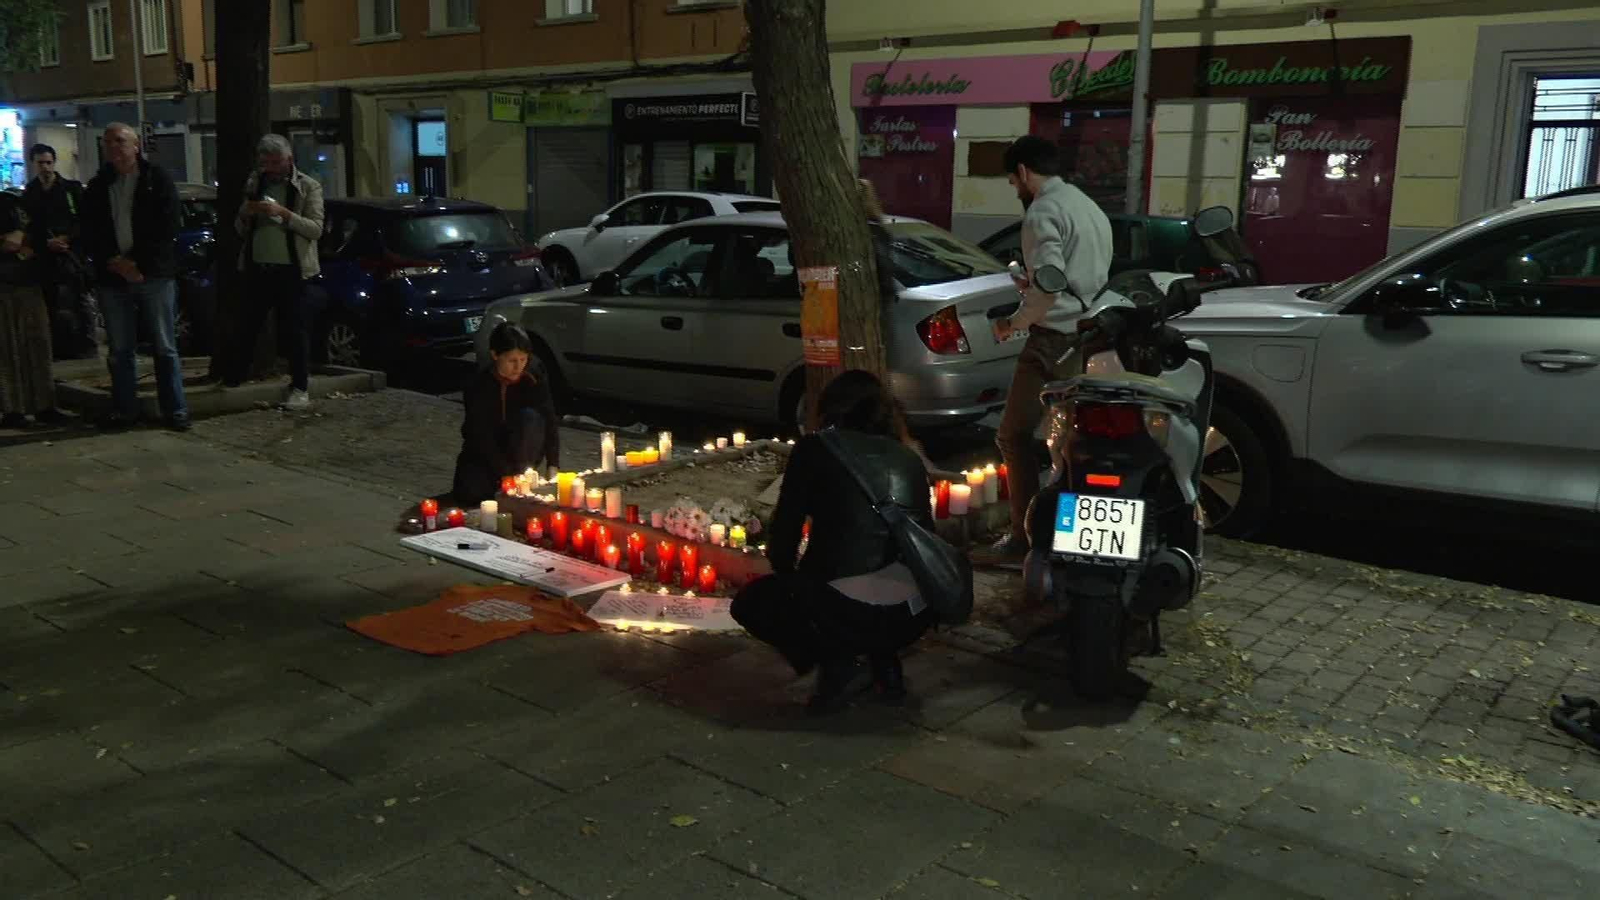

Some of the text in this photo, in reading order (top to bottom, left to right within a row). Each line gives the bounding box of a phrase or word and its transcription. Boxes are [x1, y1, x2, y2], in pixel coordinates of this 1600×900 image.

[636, 105, 697, 115] ENTRENAMIENTO
[1264, 105, 1317, 124] Pan
[868, 114, 919, 132] Tartas
[886, 134, 939, 152] Postres
[1277, 130, 1376, 151] Bollería
[1078, 498, 1136, 525] 8651
[1079, 527, 1125, 554] GTN
